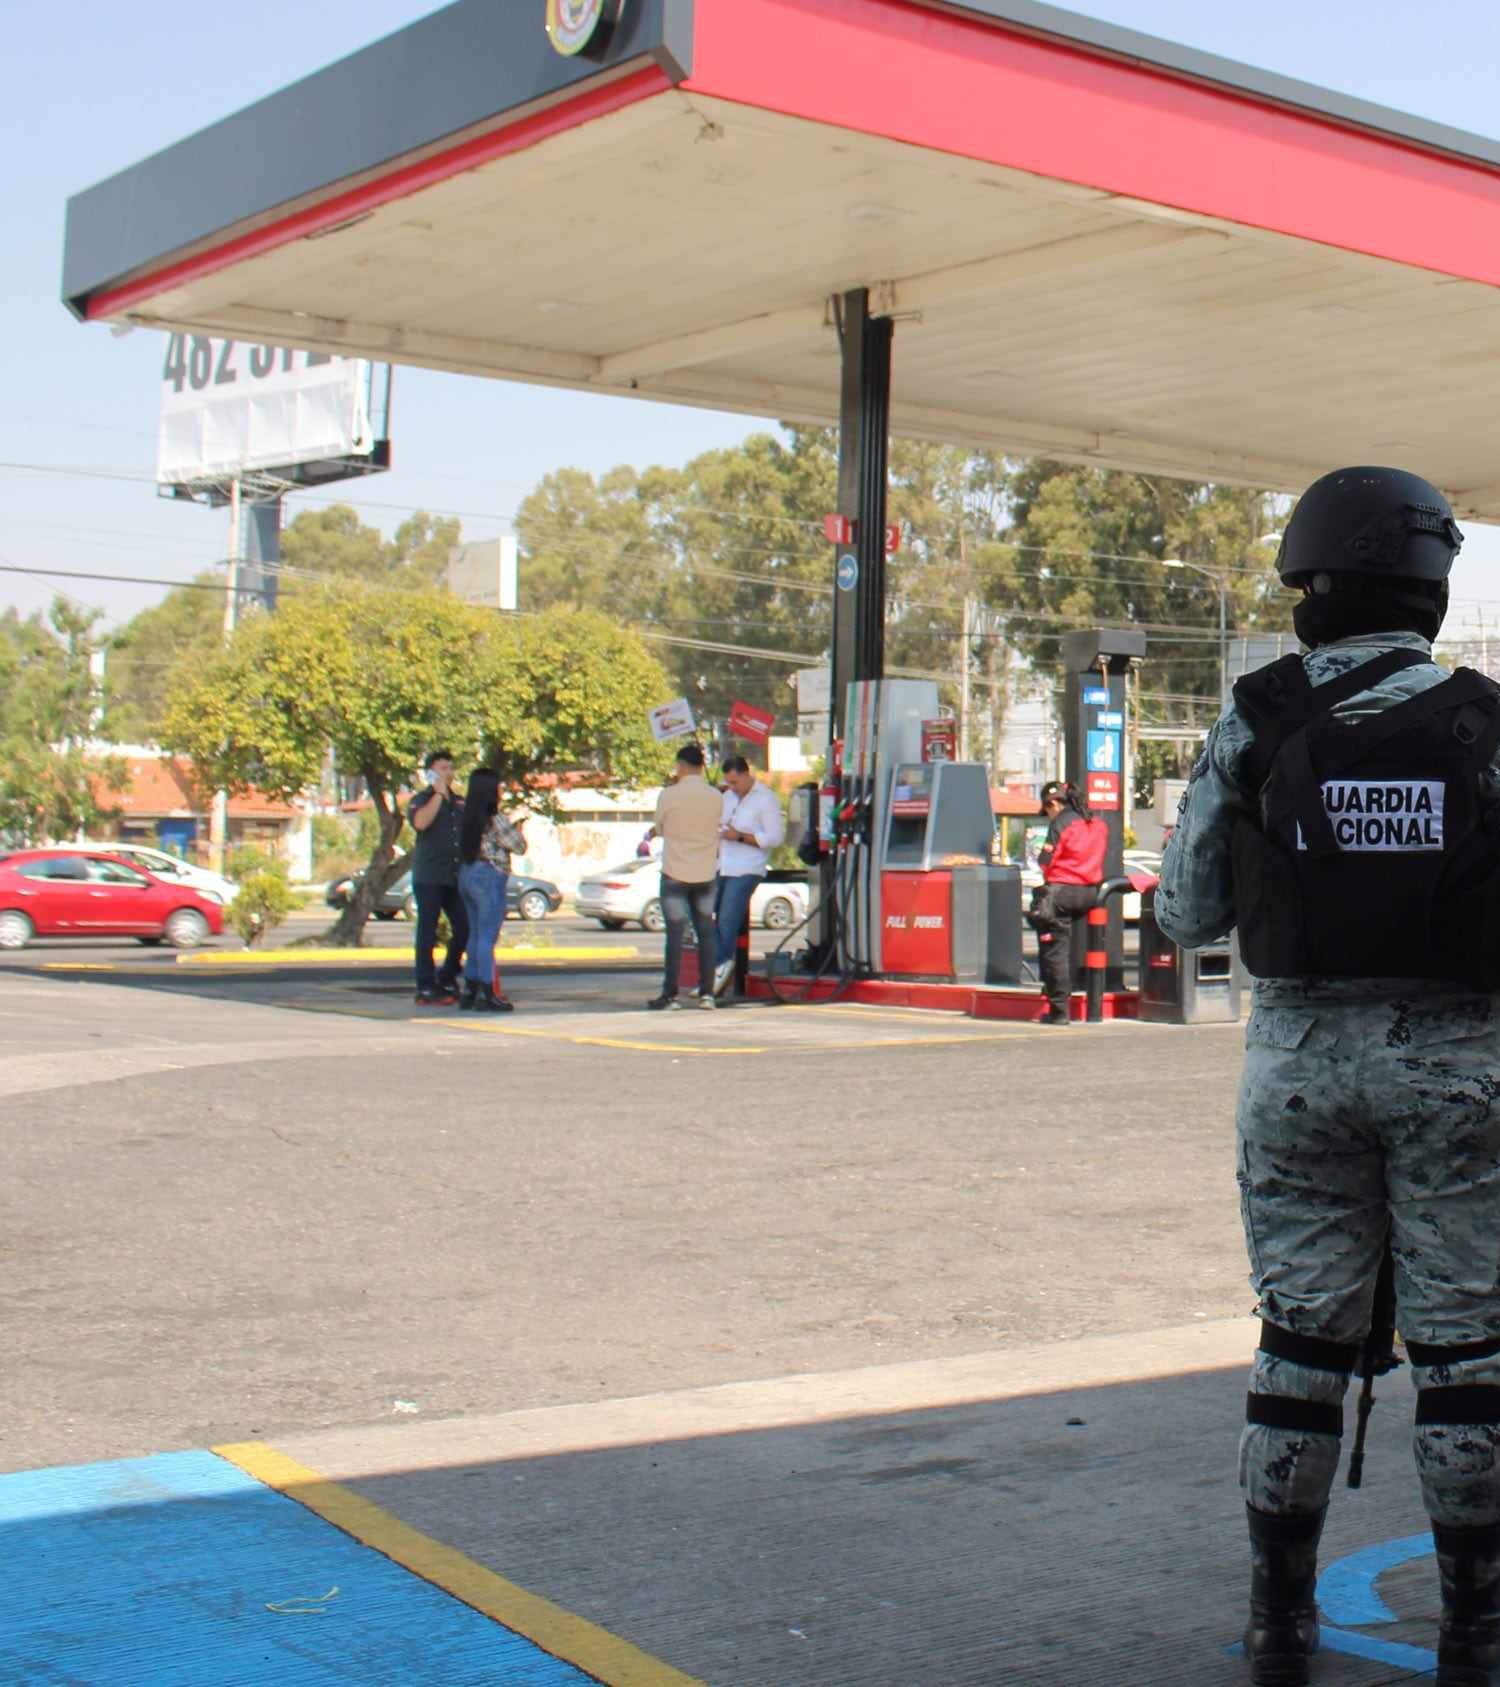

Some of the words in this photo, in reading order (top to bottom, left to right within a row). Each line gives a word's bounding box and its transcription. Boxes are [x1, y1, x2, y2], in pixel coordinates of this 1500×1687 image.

[835, 519, 843, 540] 1
[885, 528, 894, 550] 2
[1322, 785, 1433, 814] UARDIA
[1336, 817, 1440, 846] CIONAL
